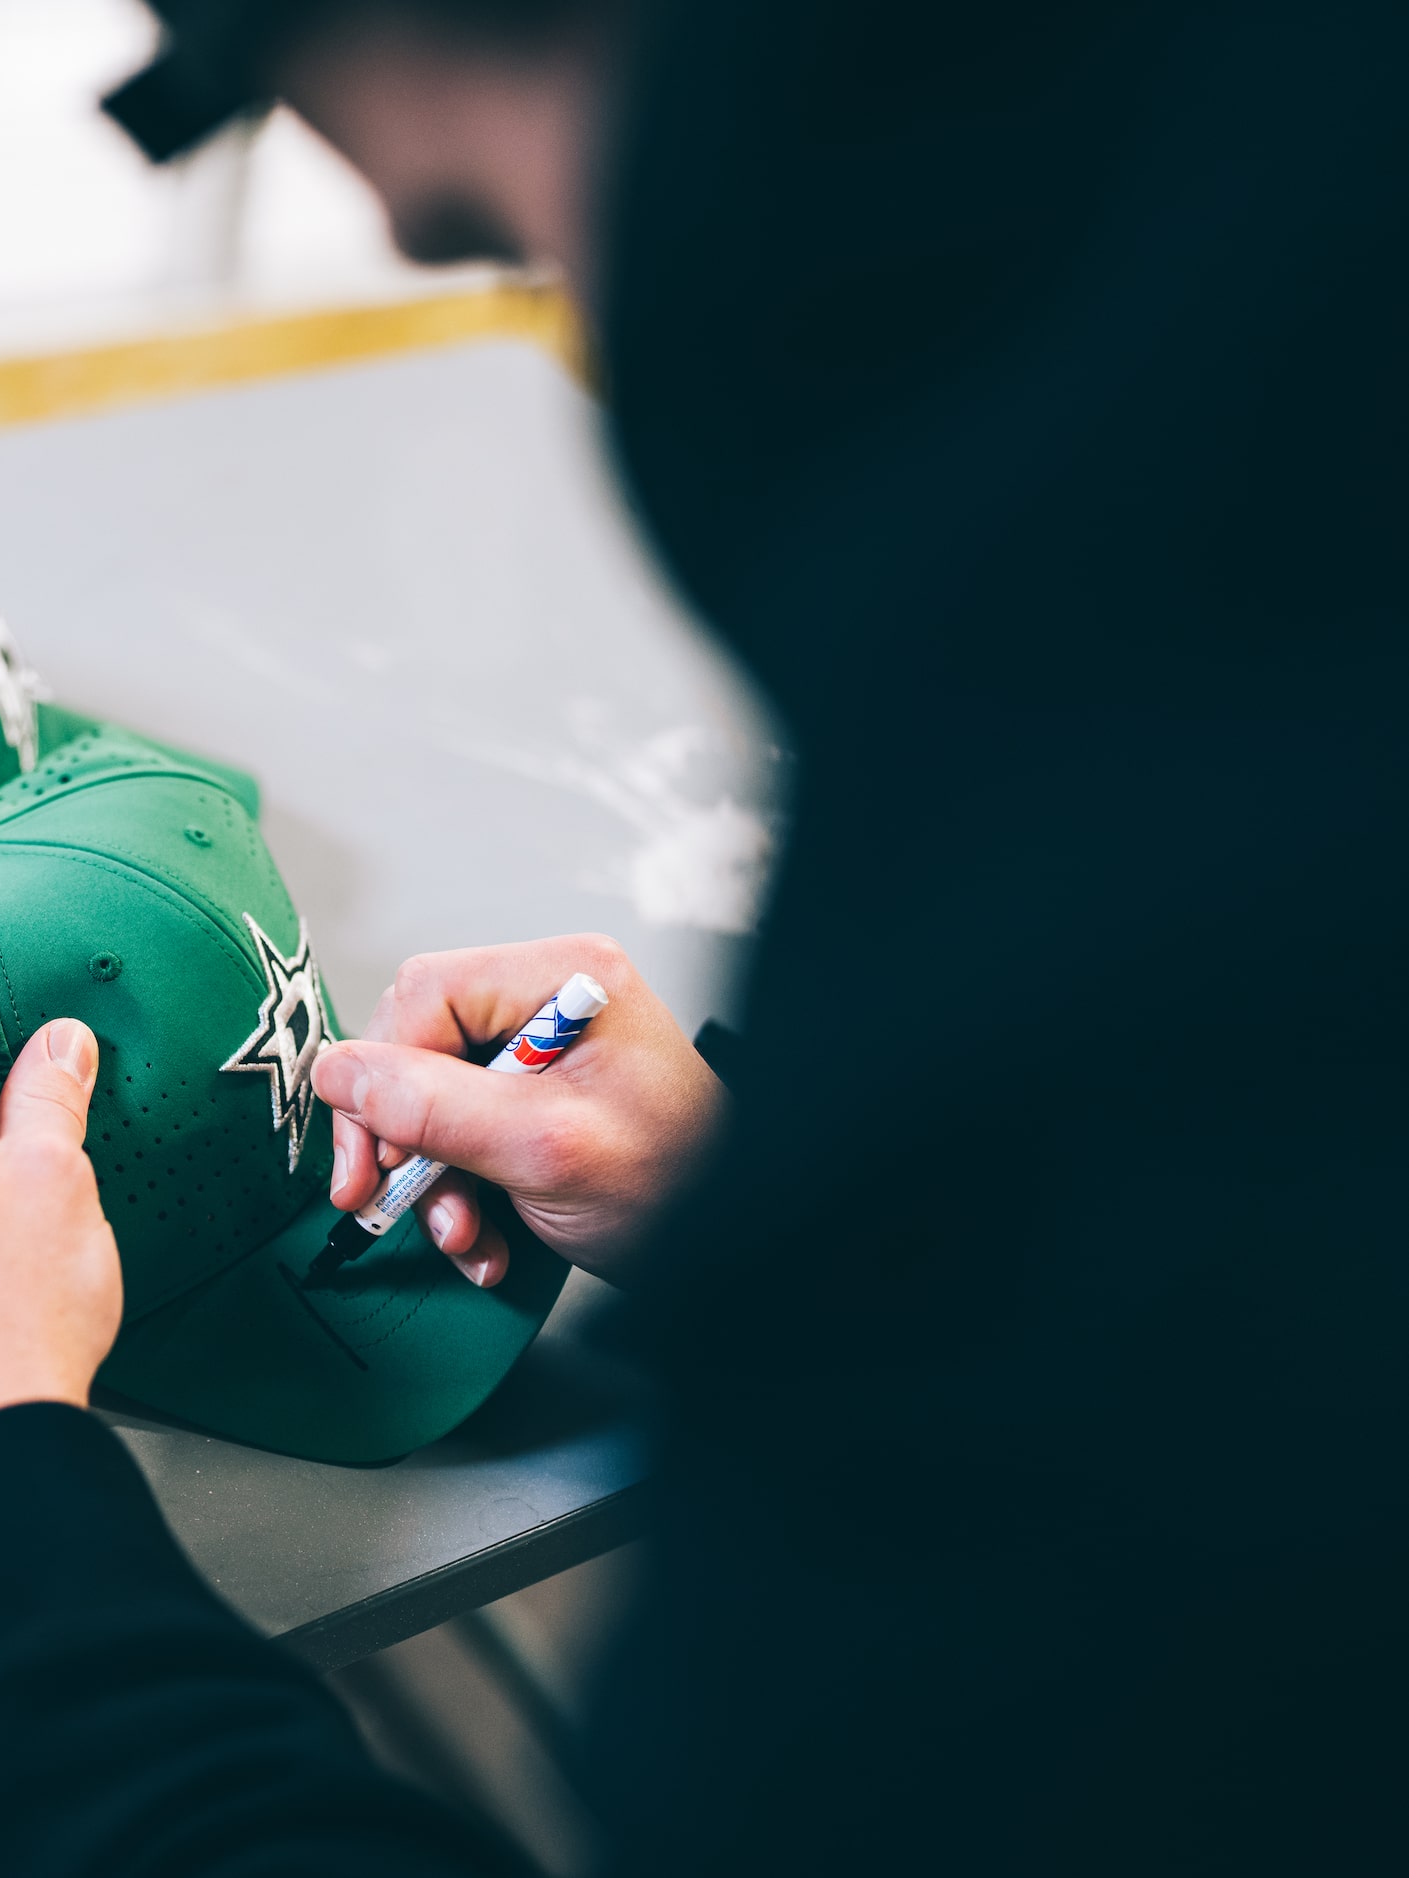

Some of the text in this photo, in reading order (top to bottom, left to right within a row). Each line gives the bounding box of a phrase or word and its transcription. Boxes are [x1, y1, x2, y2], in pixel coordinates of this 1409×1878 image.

[375, 1195, 387, 1208] FOR
[386, 1174, 409, 1198] MARKING
[407, 1166, 417, 1176] ON
[380, 1190, 404, 1213] SUITABLE
[403, 1179, 415, 1191] FOR
